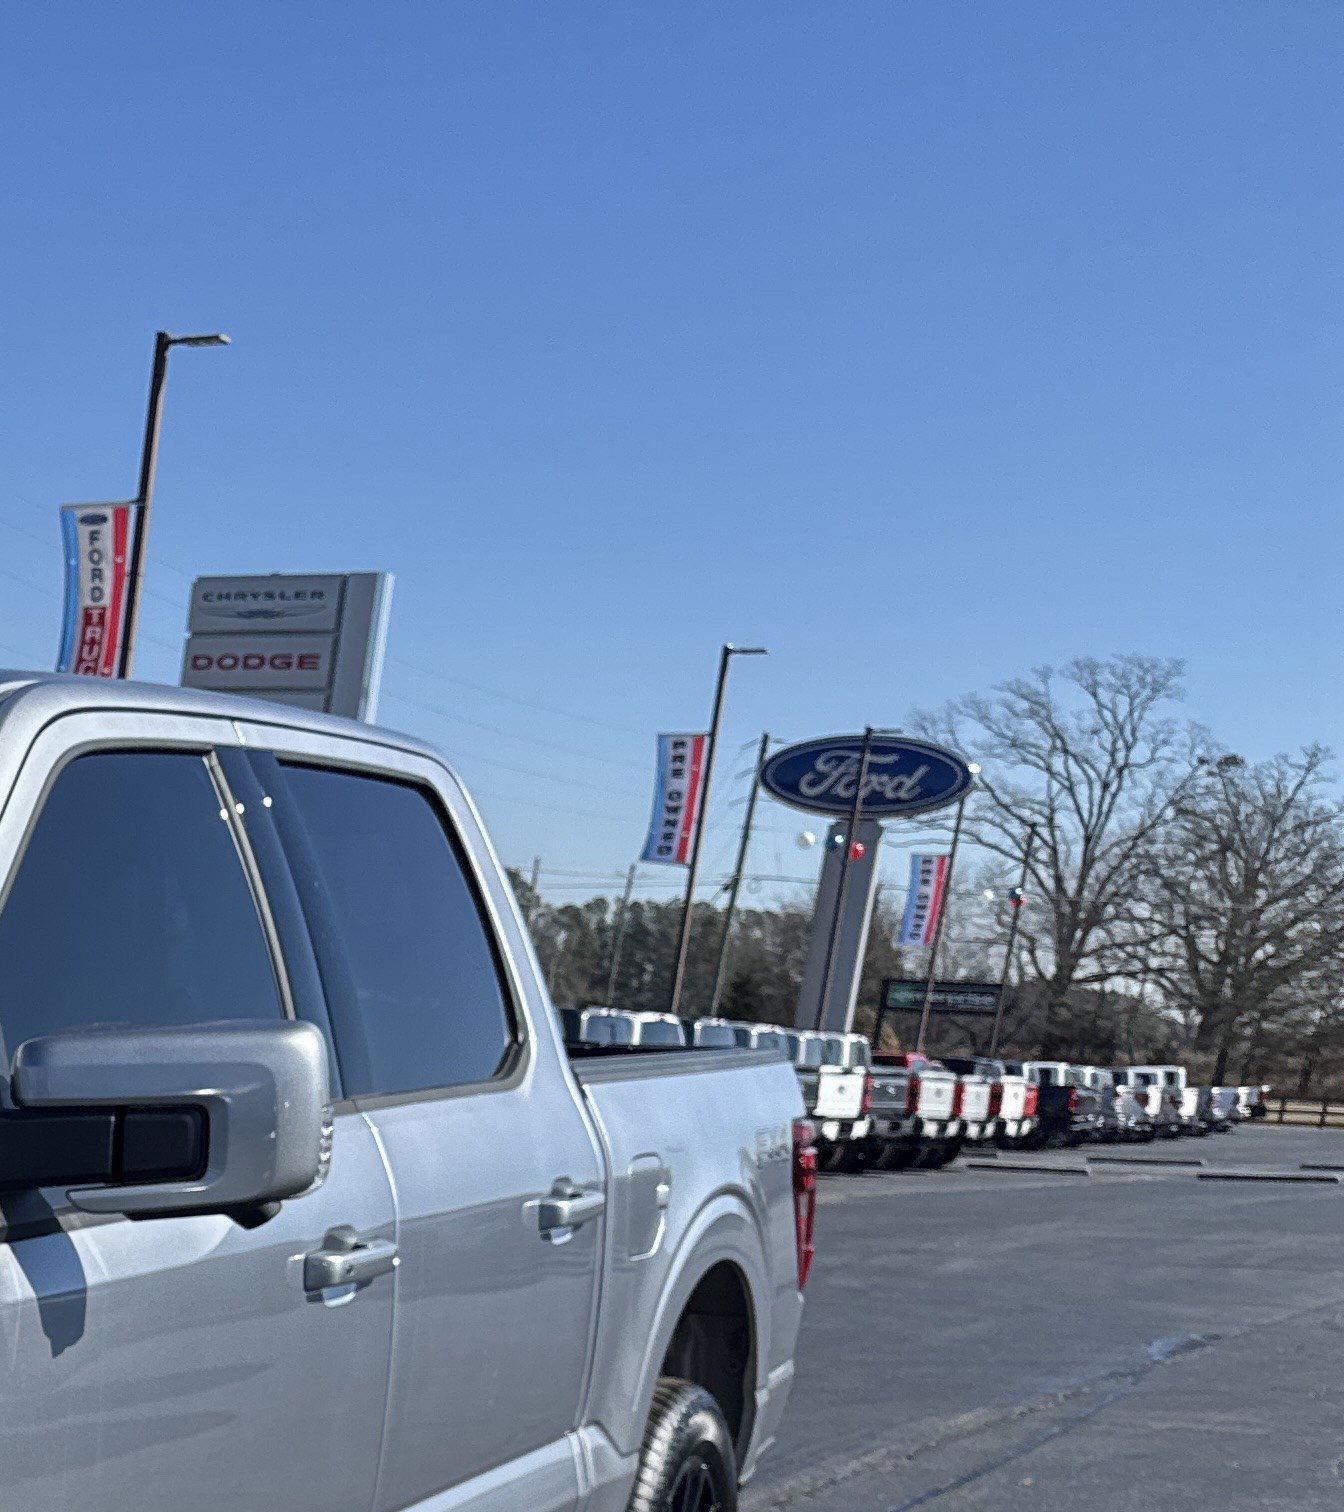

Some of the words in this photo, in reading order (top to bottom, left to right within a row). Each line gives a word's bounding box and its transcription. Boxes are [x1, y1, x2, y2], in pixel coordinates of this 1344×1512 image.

[88, 530, 104, 603] FORD
[201, 590, 326, 603] CHRYSLER
[191, 653, 321, 671] DODGE
[798, 750, 931, 800] Ford
